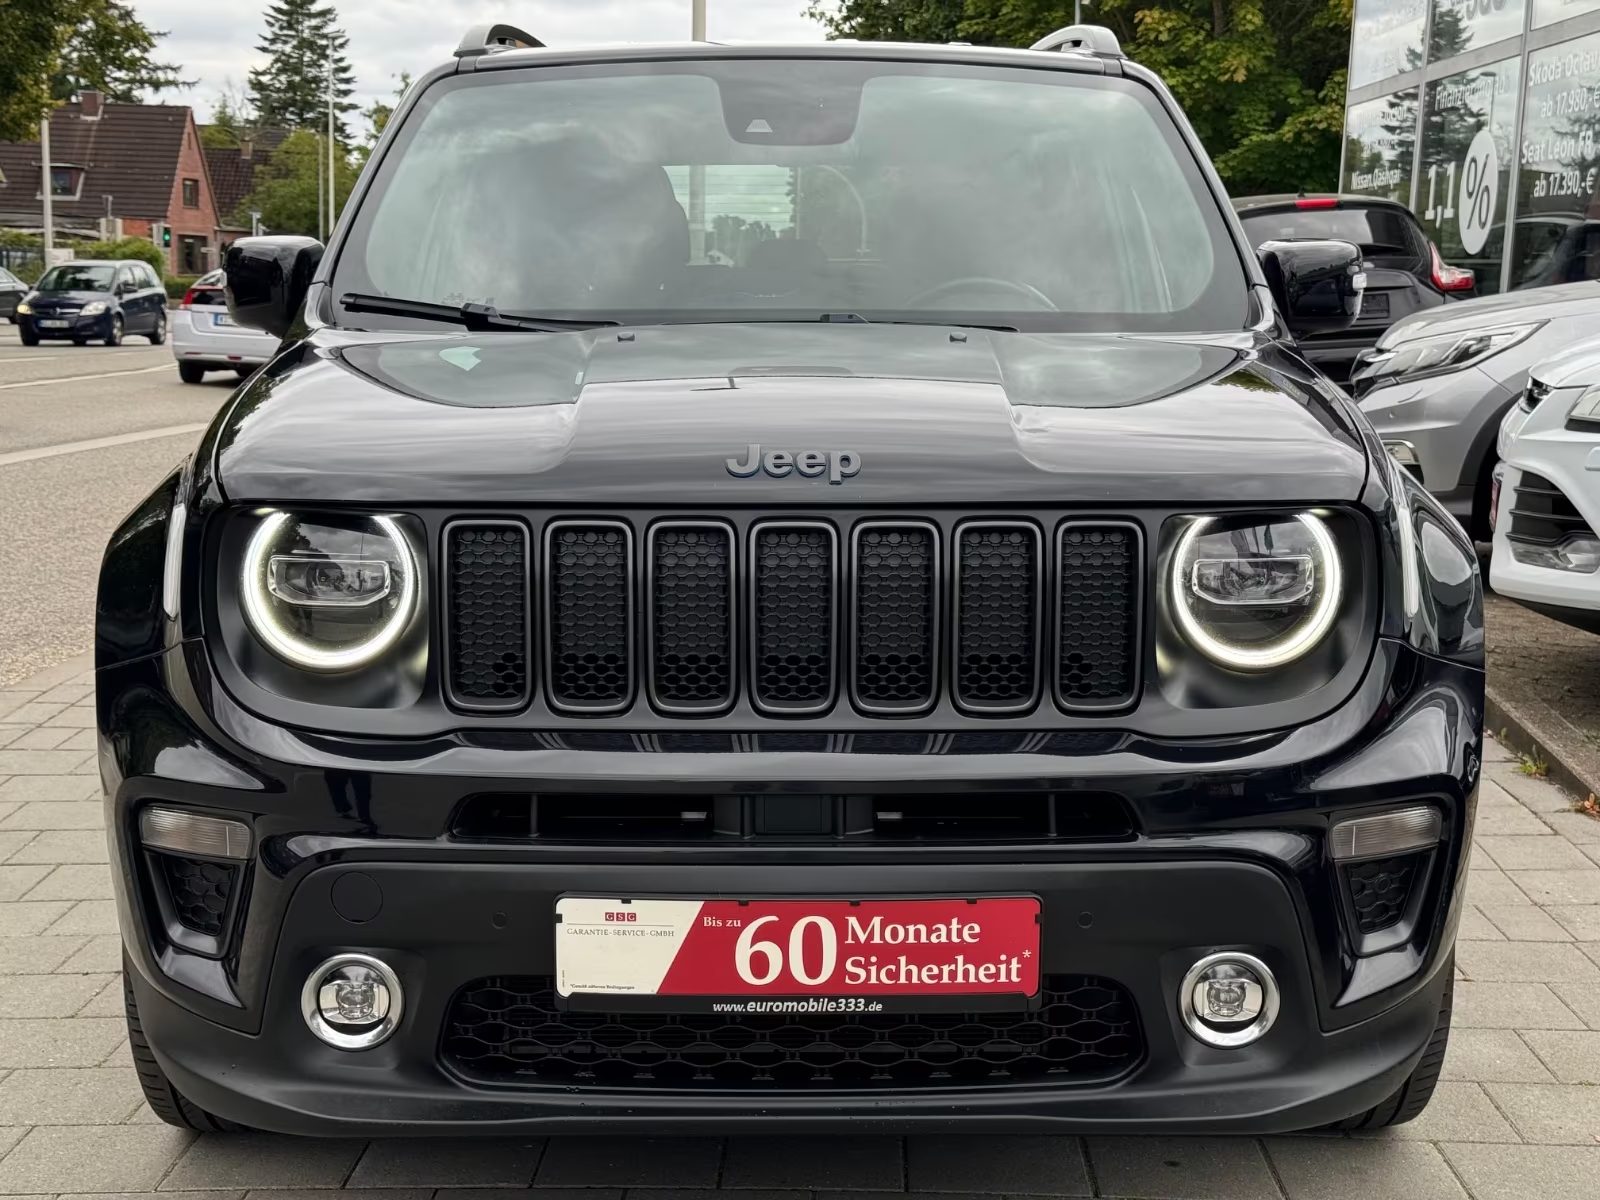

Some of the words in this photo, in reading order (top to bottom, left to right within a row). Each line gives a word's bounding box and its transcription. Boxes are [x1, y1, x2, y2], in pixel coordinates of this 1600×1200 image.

[1566, 49, 1600, 77] Octav
[1541, 93, 1553, 118] ab
[1521, 139, 1546, 164] Seat
[1548, 136, 1575, 160] Leon
[1425, 161, 1456, 229] 1,1
[1466, 153, 1491, 230] %
[1533, 172, 1546, 198] ab
[725, 443, 862, 485] Jeep
[703, 916, 723, 928] Bis
[726, 918, 742, 928] zu
[844, 916, 980, 944] Monate
[735, 915, 837, 985] 60
[712, 997, 883, 1012] www.euromobile333.de
